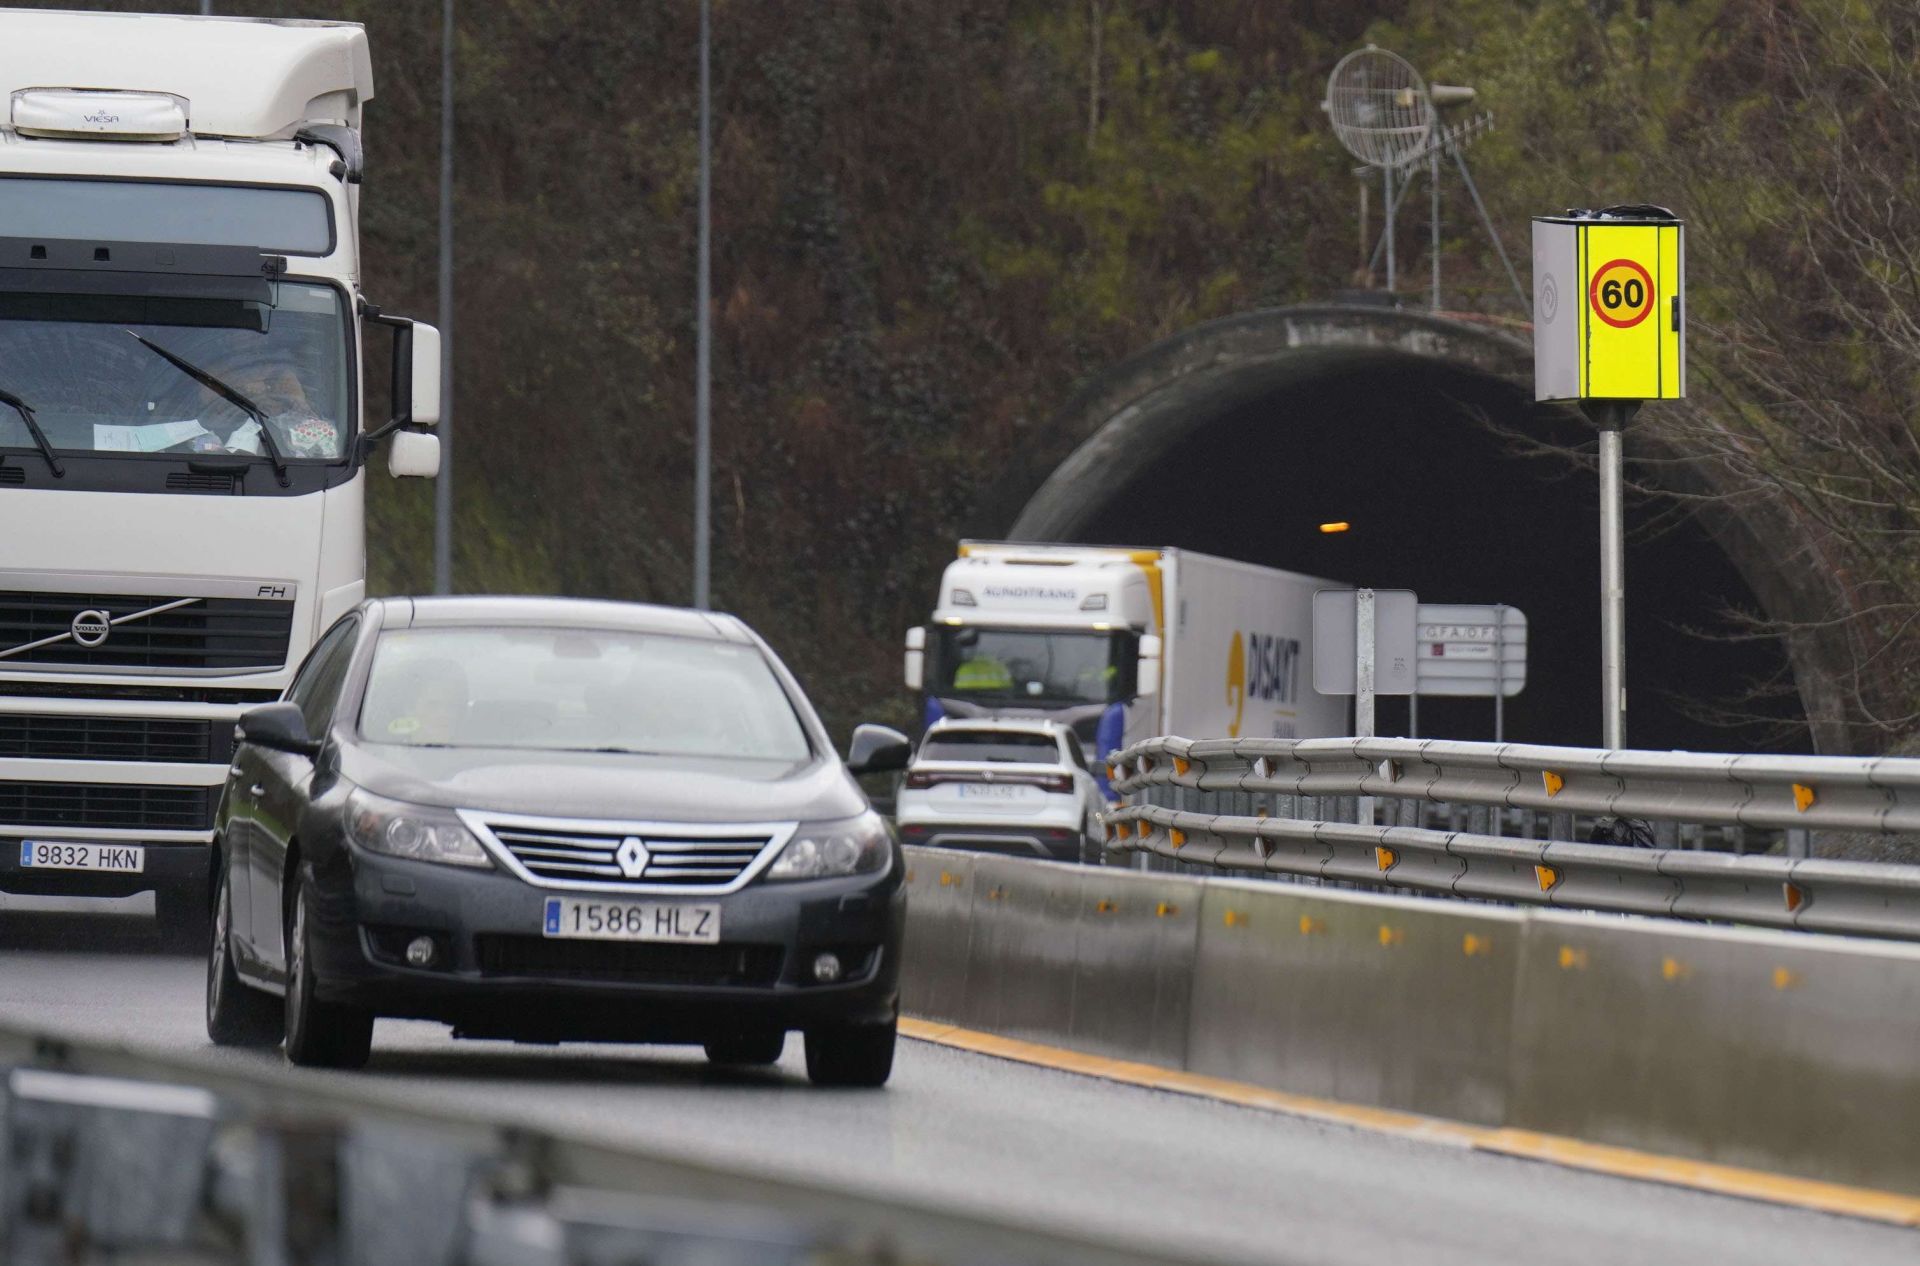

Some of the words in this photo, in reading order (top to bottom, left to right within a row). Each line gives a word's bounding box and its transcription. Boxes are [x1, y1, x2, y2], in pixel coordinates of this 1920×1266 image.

[1602, 279, 1643, 309] 60
[257, 586, 286, 598] FH
[37, 845, 89, 867] 9832
[98, 848, 137, 869] HKN
[572, 904, 643, 934] 1586
[654, 908, 711, 937] HLZ
